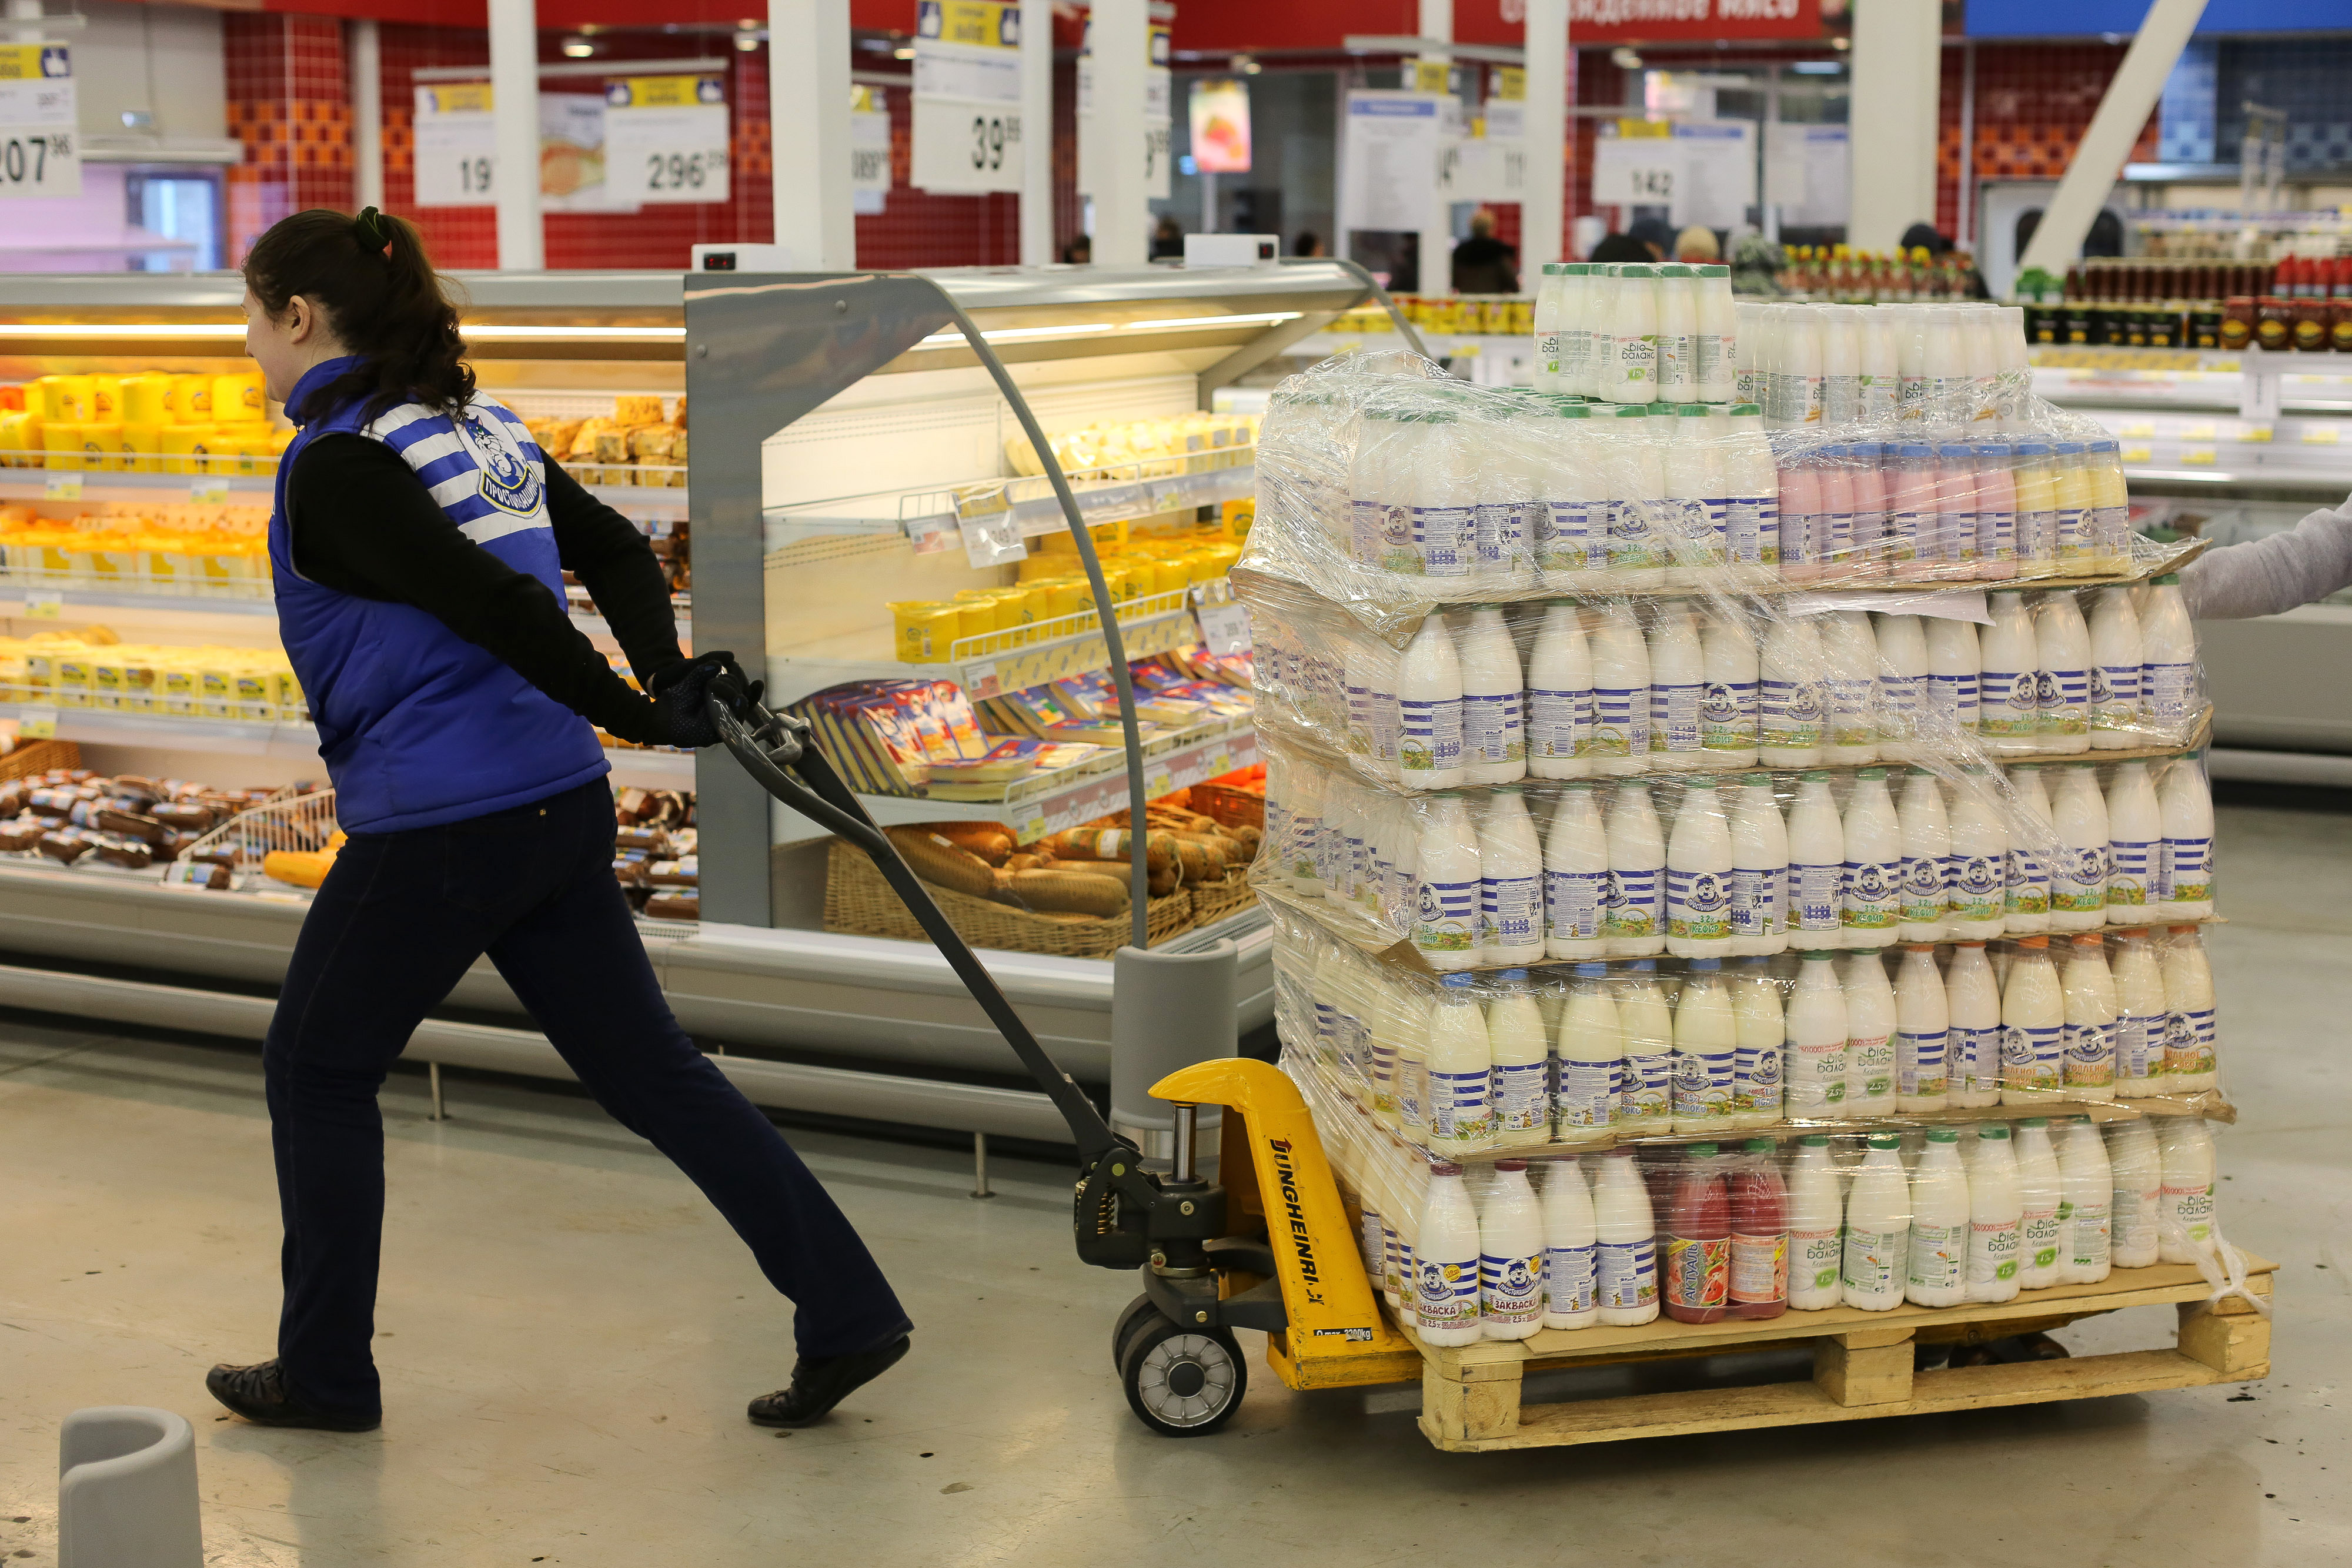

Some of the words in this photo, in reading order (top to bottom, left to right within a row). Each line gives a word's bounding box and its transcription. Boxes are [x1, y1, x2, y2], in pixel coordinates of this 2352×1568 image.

[971, 115, 1003, 172] 39
[0, 136, 46, 182] 07
[648, 151, 706, 190] 296
[1622, 351, 1655, 359] Баланс
[485, 476, 539, 510] ПРОСТОКВАШИНО
[1905, 883, 1942, 895] ПРОСТОКВАШИНО
[1959, 881, 1996, 894] ПРОСТОКВАШИНО
[1852, 888, 1889, 901] ПРОСТОКВАШИНО
[1687, 898, 1723, 911] ПРОСТОКВАШИНО
[1856, 914, 1884, 922] КЕФИР
[1909, 908, 1937, 917] КЕФИР
[1691, 924, 1719, 934] КЕФИР
[1622, 1081, 1643, 1092] КВАШИНО
[1753, 1096, 1777, 1107] МОЛО
[1622, 1105, 1642, 1115] ЛОКО
[1270, 1138, 1325, 1305] JUNGHEINRI
[2040, 1253, 2052, 1262] 1%
[1685, 1243, 1699, 1302] АКТУАЛЬ
[2002, 1267, 2013, 1276] 1%
[1419, 1285, 1452, 1300] ПРОСТОКВАШИНО
[1499, 1282, 1535, 1296] ПРОСТОКВАШИНО
